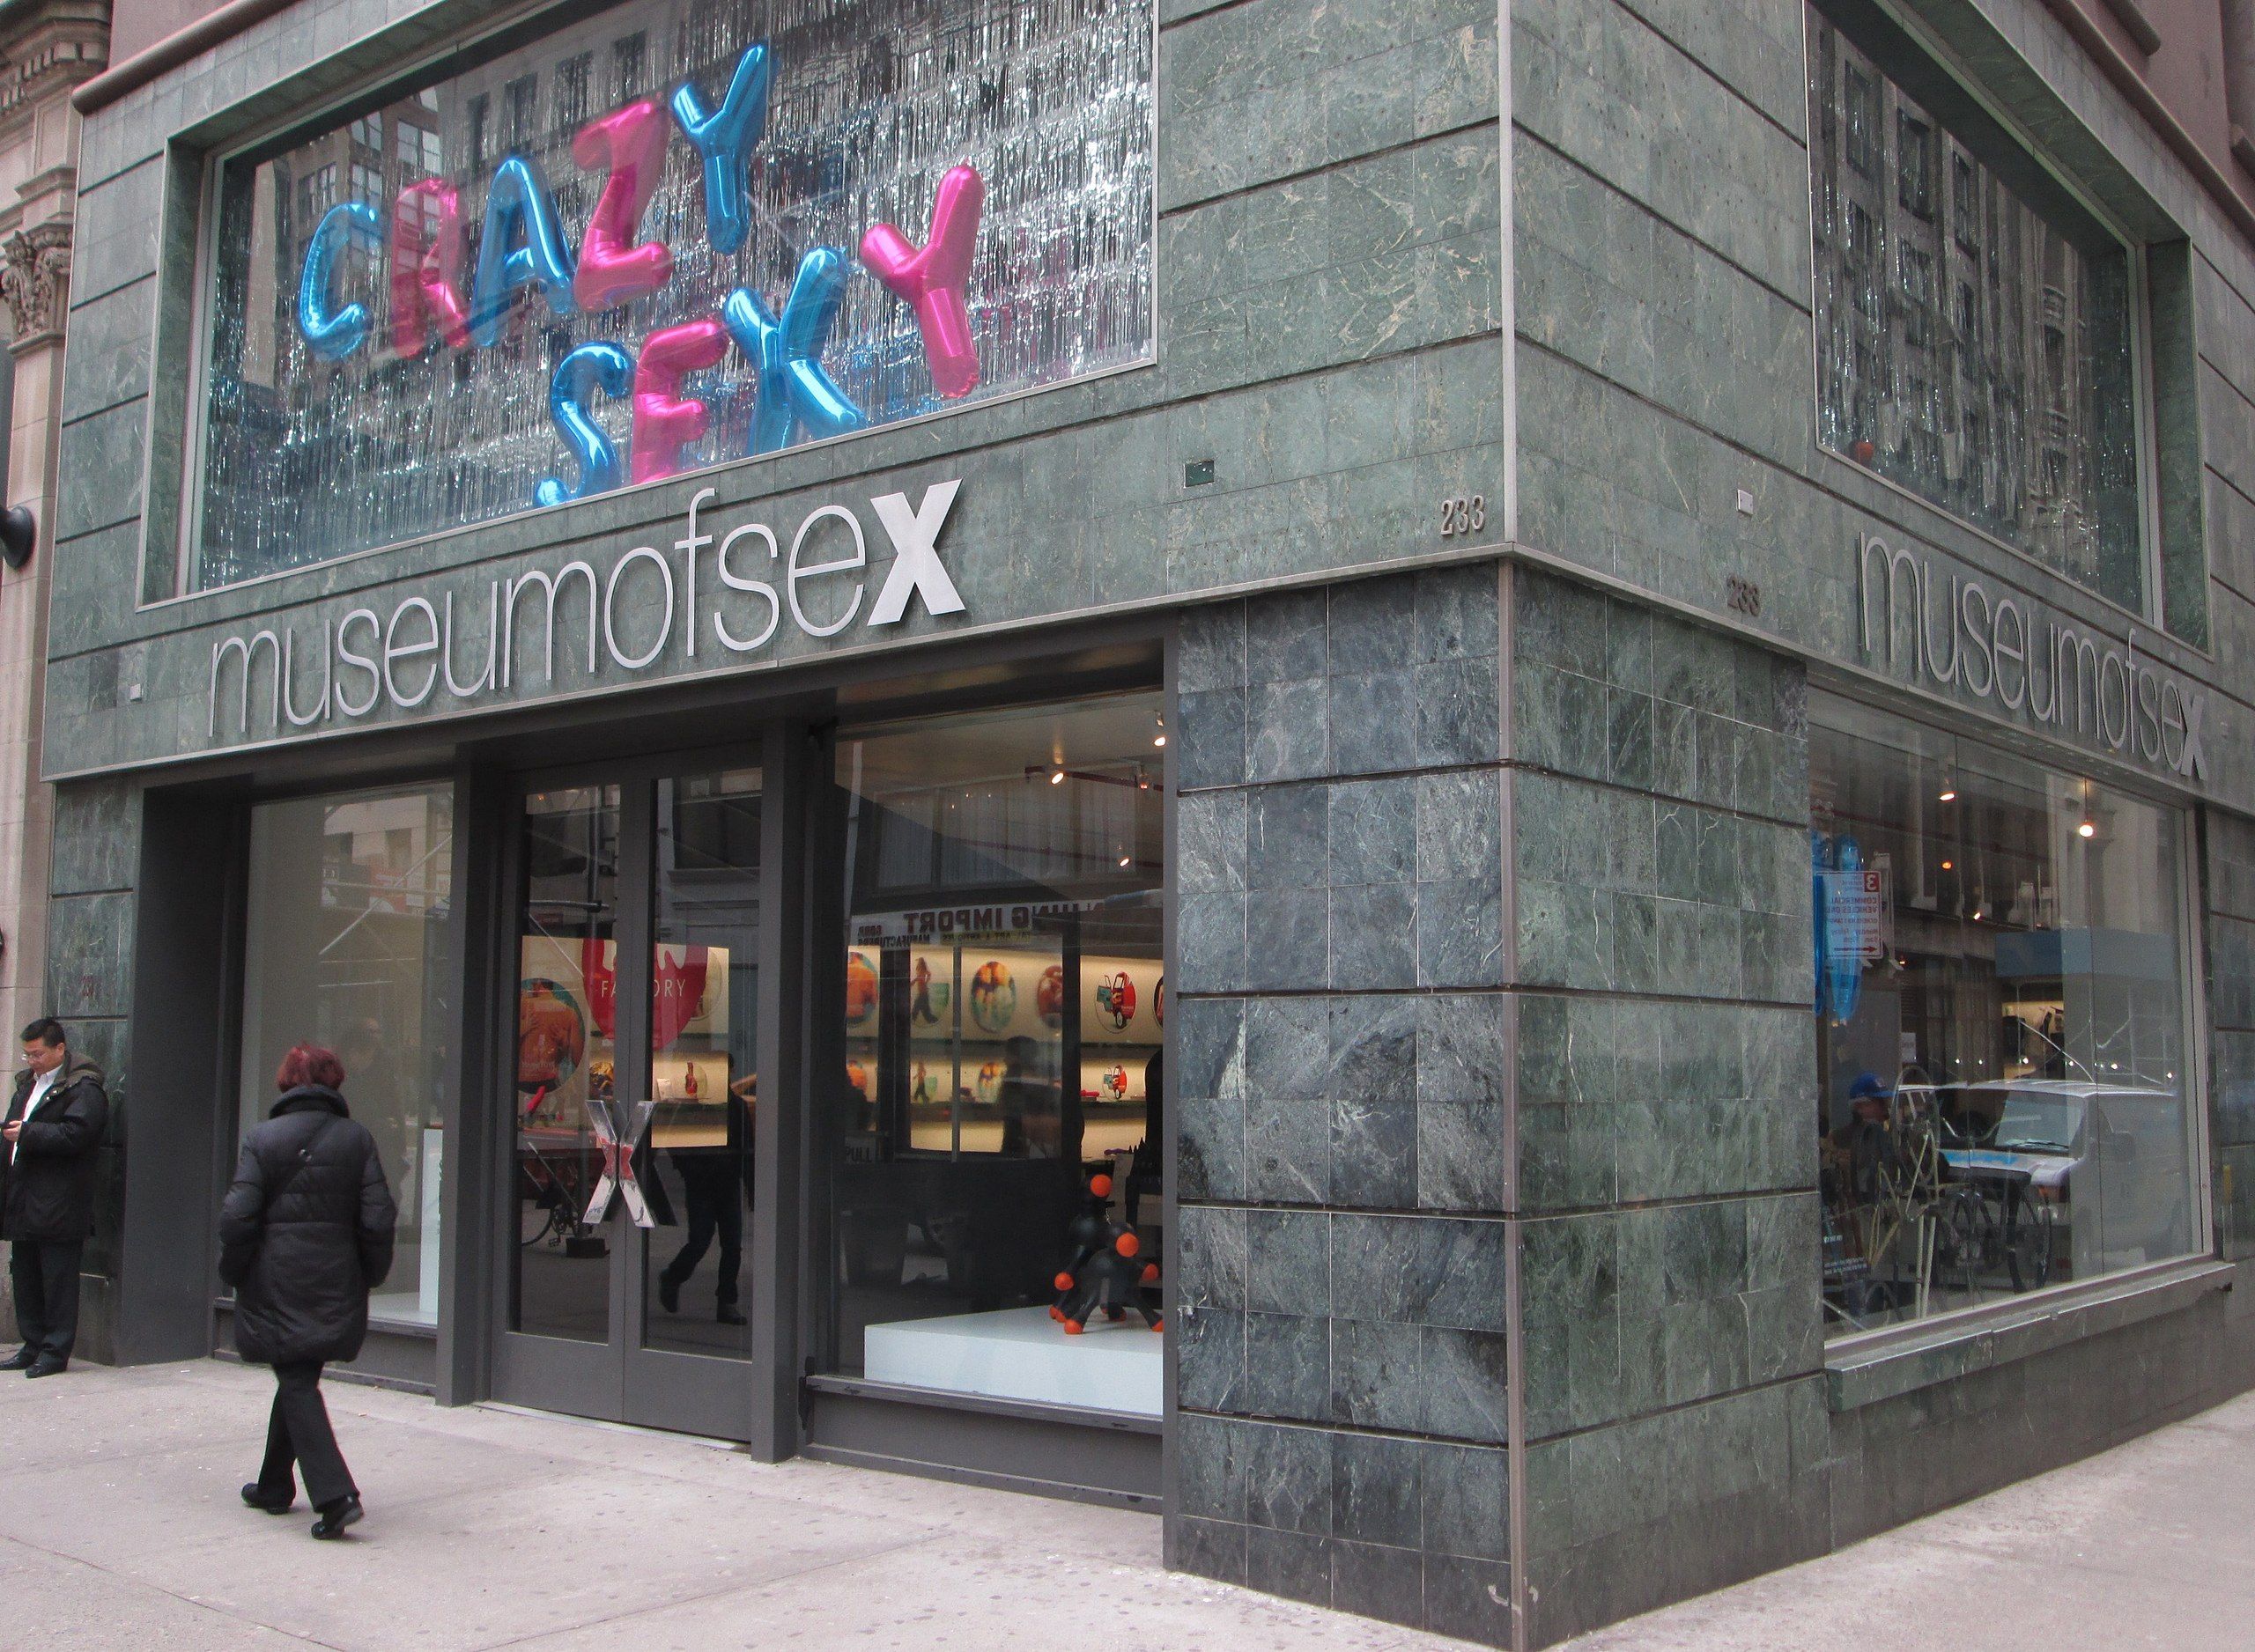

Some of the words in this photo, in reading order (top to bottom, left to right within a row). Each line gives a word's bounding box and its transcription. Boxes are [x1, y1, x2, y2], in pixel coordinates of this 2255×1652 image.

[299, 42, 773, 363] CRAZY
[536, 165, 984, 509] SEXY
[1441, 495, 1485, 536] 233
[1726, 572, 1761, 616] 233
[602, 978, 686, 999] FAORY
